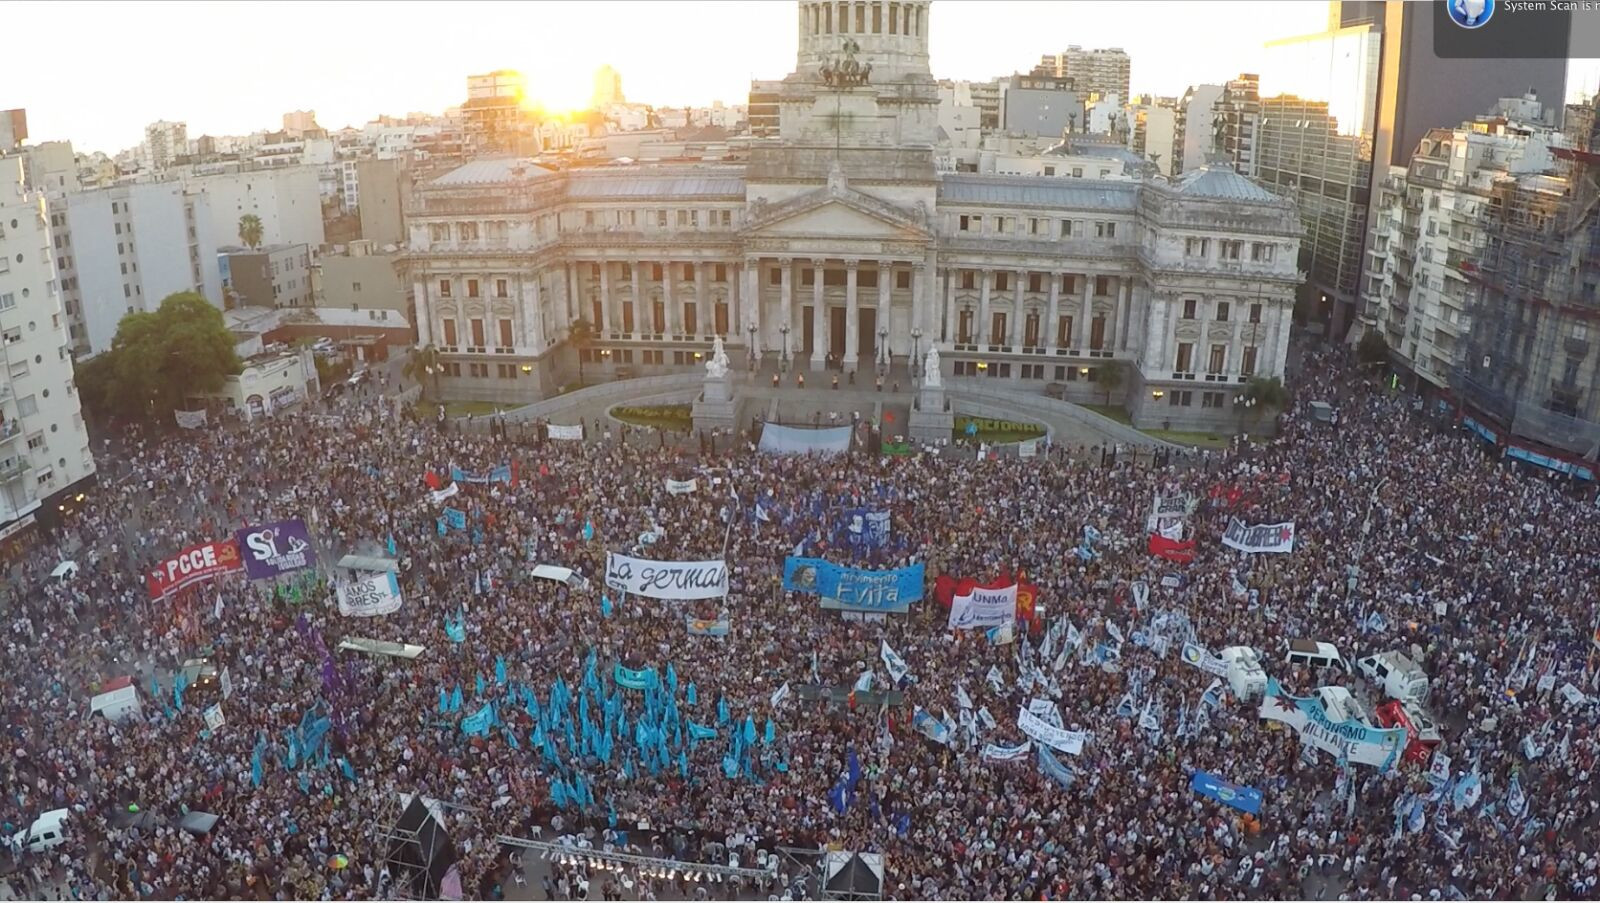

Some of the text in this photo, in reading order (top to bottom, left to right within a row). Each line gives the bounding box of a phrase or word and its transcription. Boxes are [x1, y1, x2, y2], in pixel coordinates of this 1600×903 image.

[166, 545, 218, 582] PCCE
[1302, 721, 1360, 755] MILITANTE
[1309, 705, 1367, 740] PERONISMO
